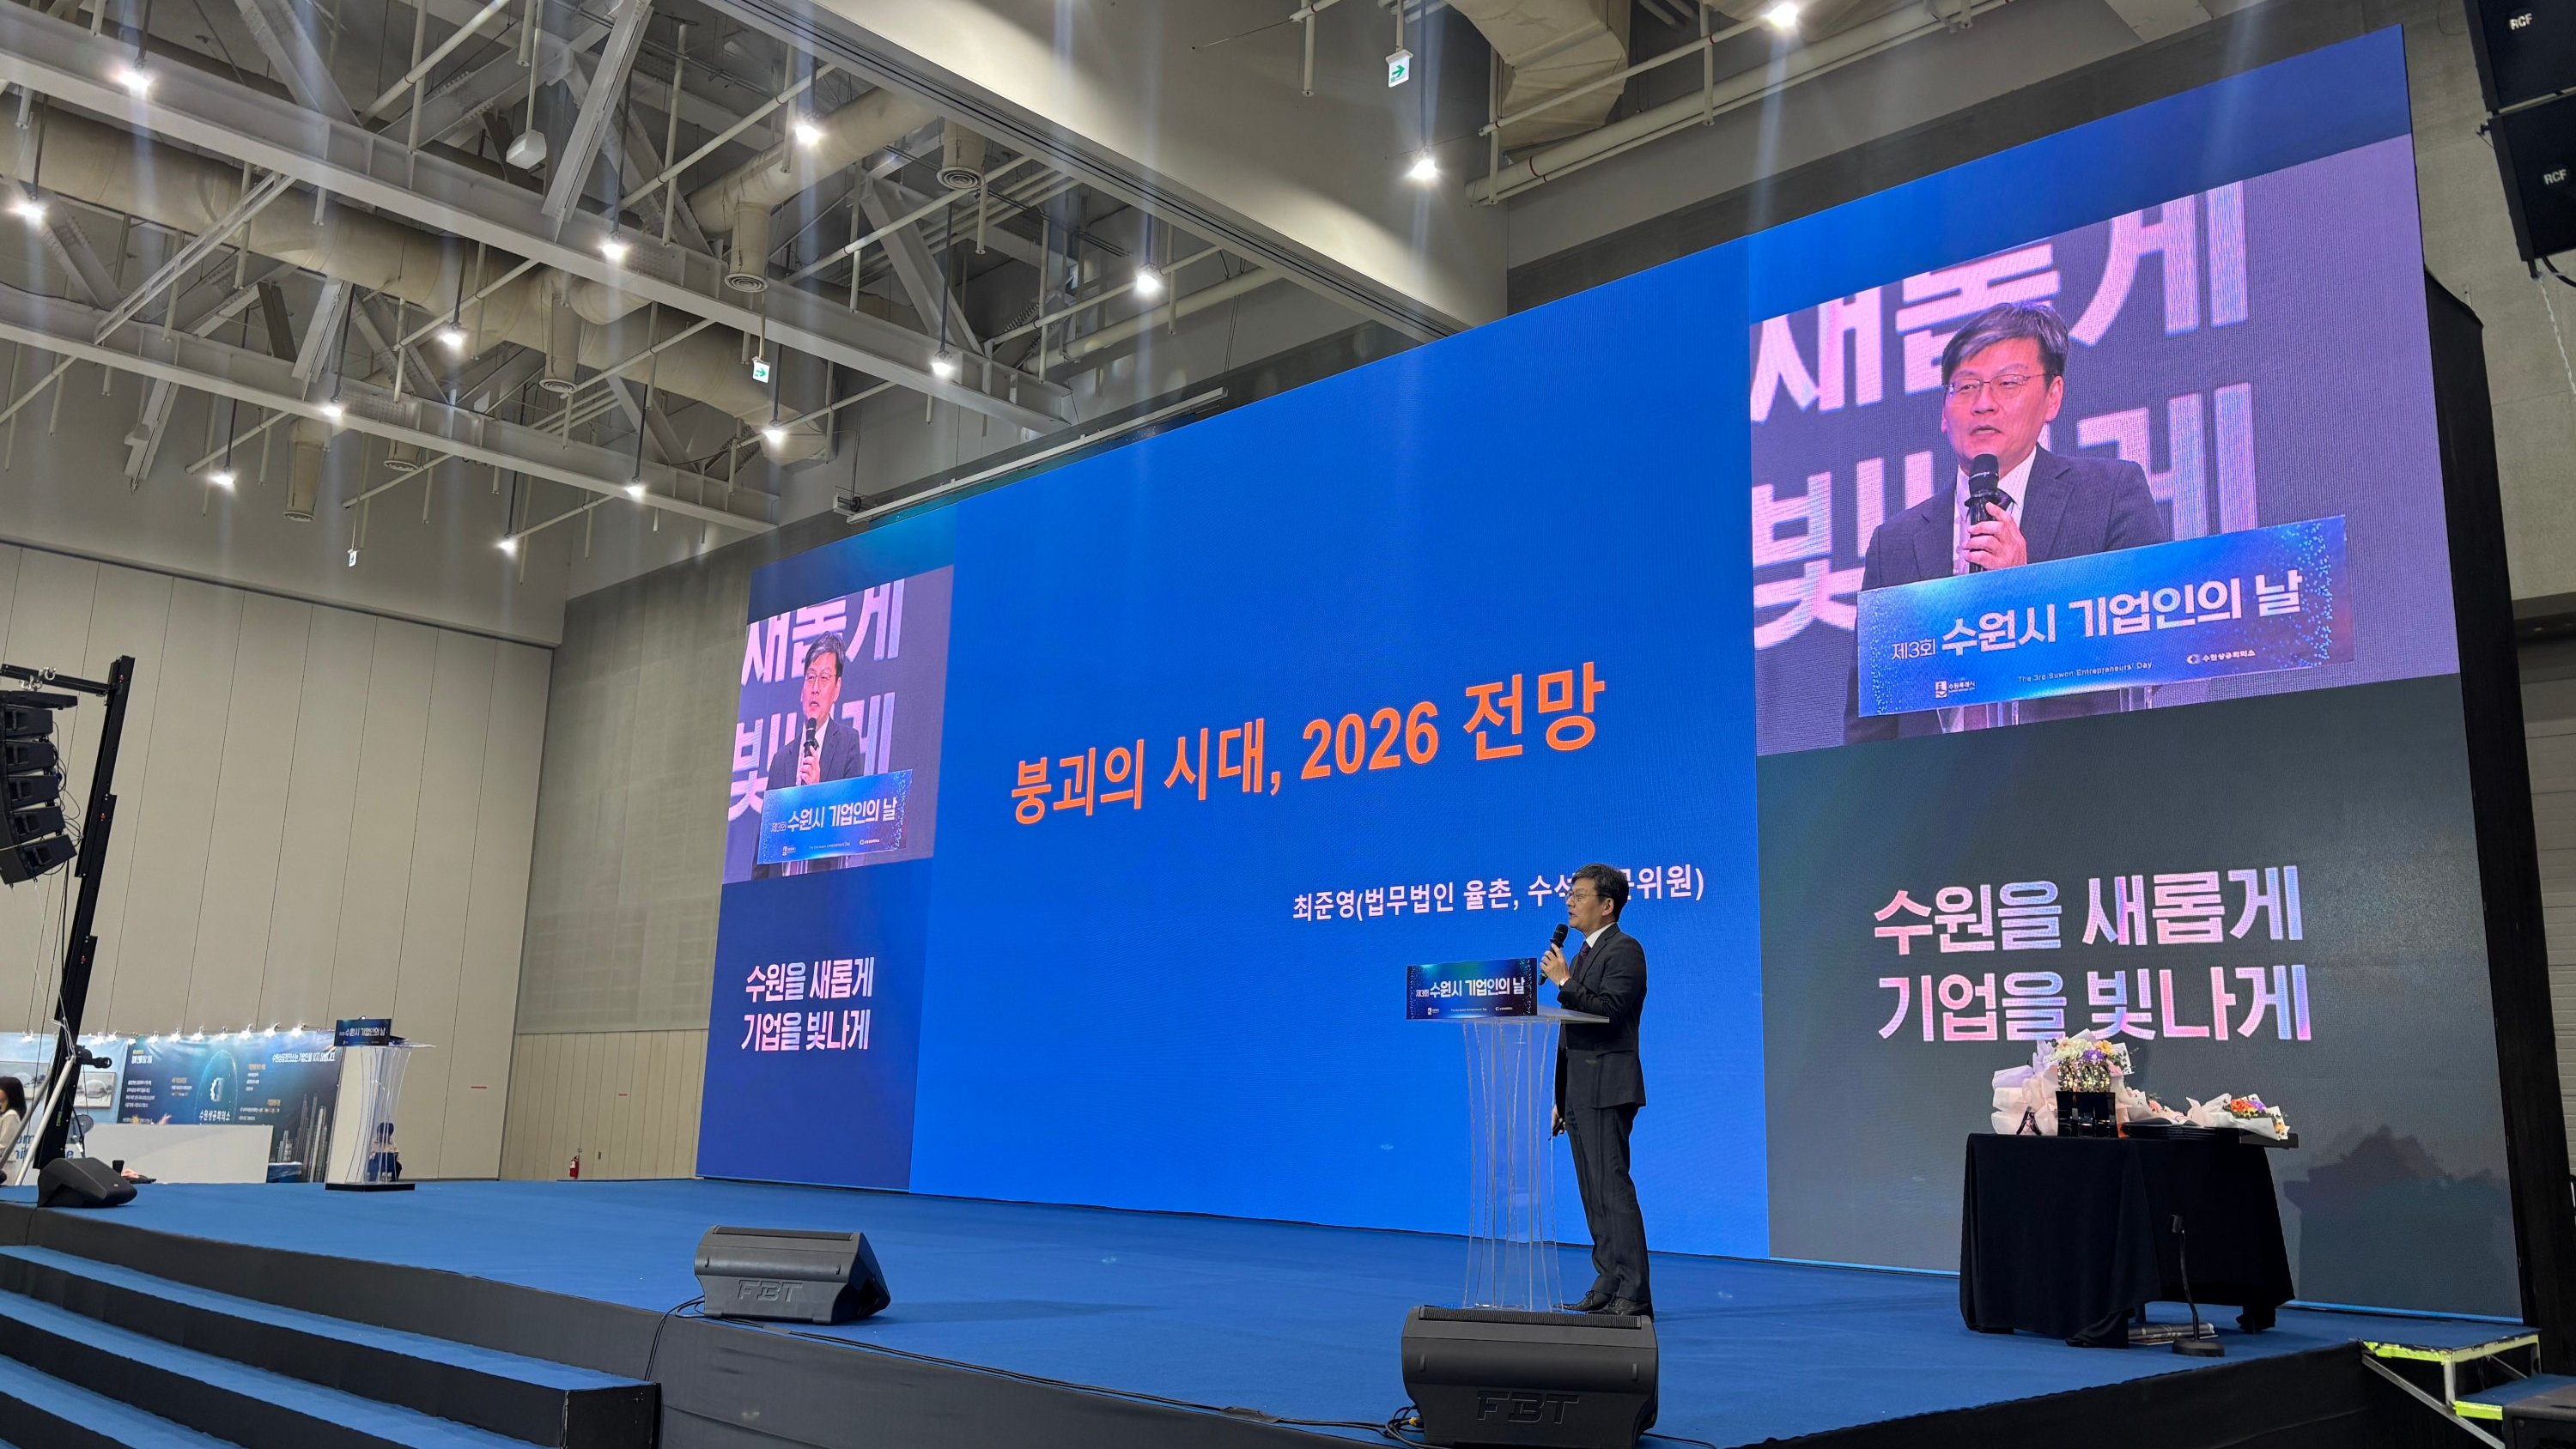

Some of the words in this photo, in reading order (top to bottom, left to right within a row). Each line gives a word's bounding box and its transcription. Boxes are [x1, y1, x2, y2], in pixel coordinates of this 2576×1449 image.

[2509, 13, 2533, 31] RCF
[2543, 169, 2567, 185] RCF
[1891, 637, 1937, 660] 제3회
[1941, 603, 2057, 657] 수원시
[2068, 578, 2243, 640] 기업인의
[2255, 568, 2304, 617] 날
[2018, 675, 2032, 683] The
[2049, 670, 2075, 680] Suwon
[2136, 661, 2153, 670] Day
[1010, 739, 1145, 825] 붕괴의
[1163, 718, 1282, 801] 시대,
[1299, 700, 1440, 779] 2026
[1461, 661, 1606, 761] 전망
[787, 807, 826, 833] 수원시
[828, 800, 879, 828] 기업인의
[883, 797, 897, 822] 날
[1292, 881, 1455, 922] 최준영(법무법인
[1462, 879, 1520, 912] 율촌,
[1873, 879, 2063, 955] 수원을
[2081, 864, 2304, 946] 새롭게
[745, 961, 806, 1003] 수원을
[809, 956, 875, 999] 새롭게
[1430, 979, 1462, 998] 수원시
[1464, 977, 1510, 996] 기업인의
[1512, 976, 1526, 995] 날
[1878, 970, 2068, 1042] 기업을
[2086, 963, 2312, 1041] 빛나게
[740, 1011, 802, 1052] 기업을
[805, 1009, 871, 1051] 빛나게
[738, 1278, 804, 1303] FBT
[1476, 1390, 1580, 1425] FBT
